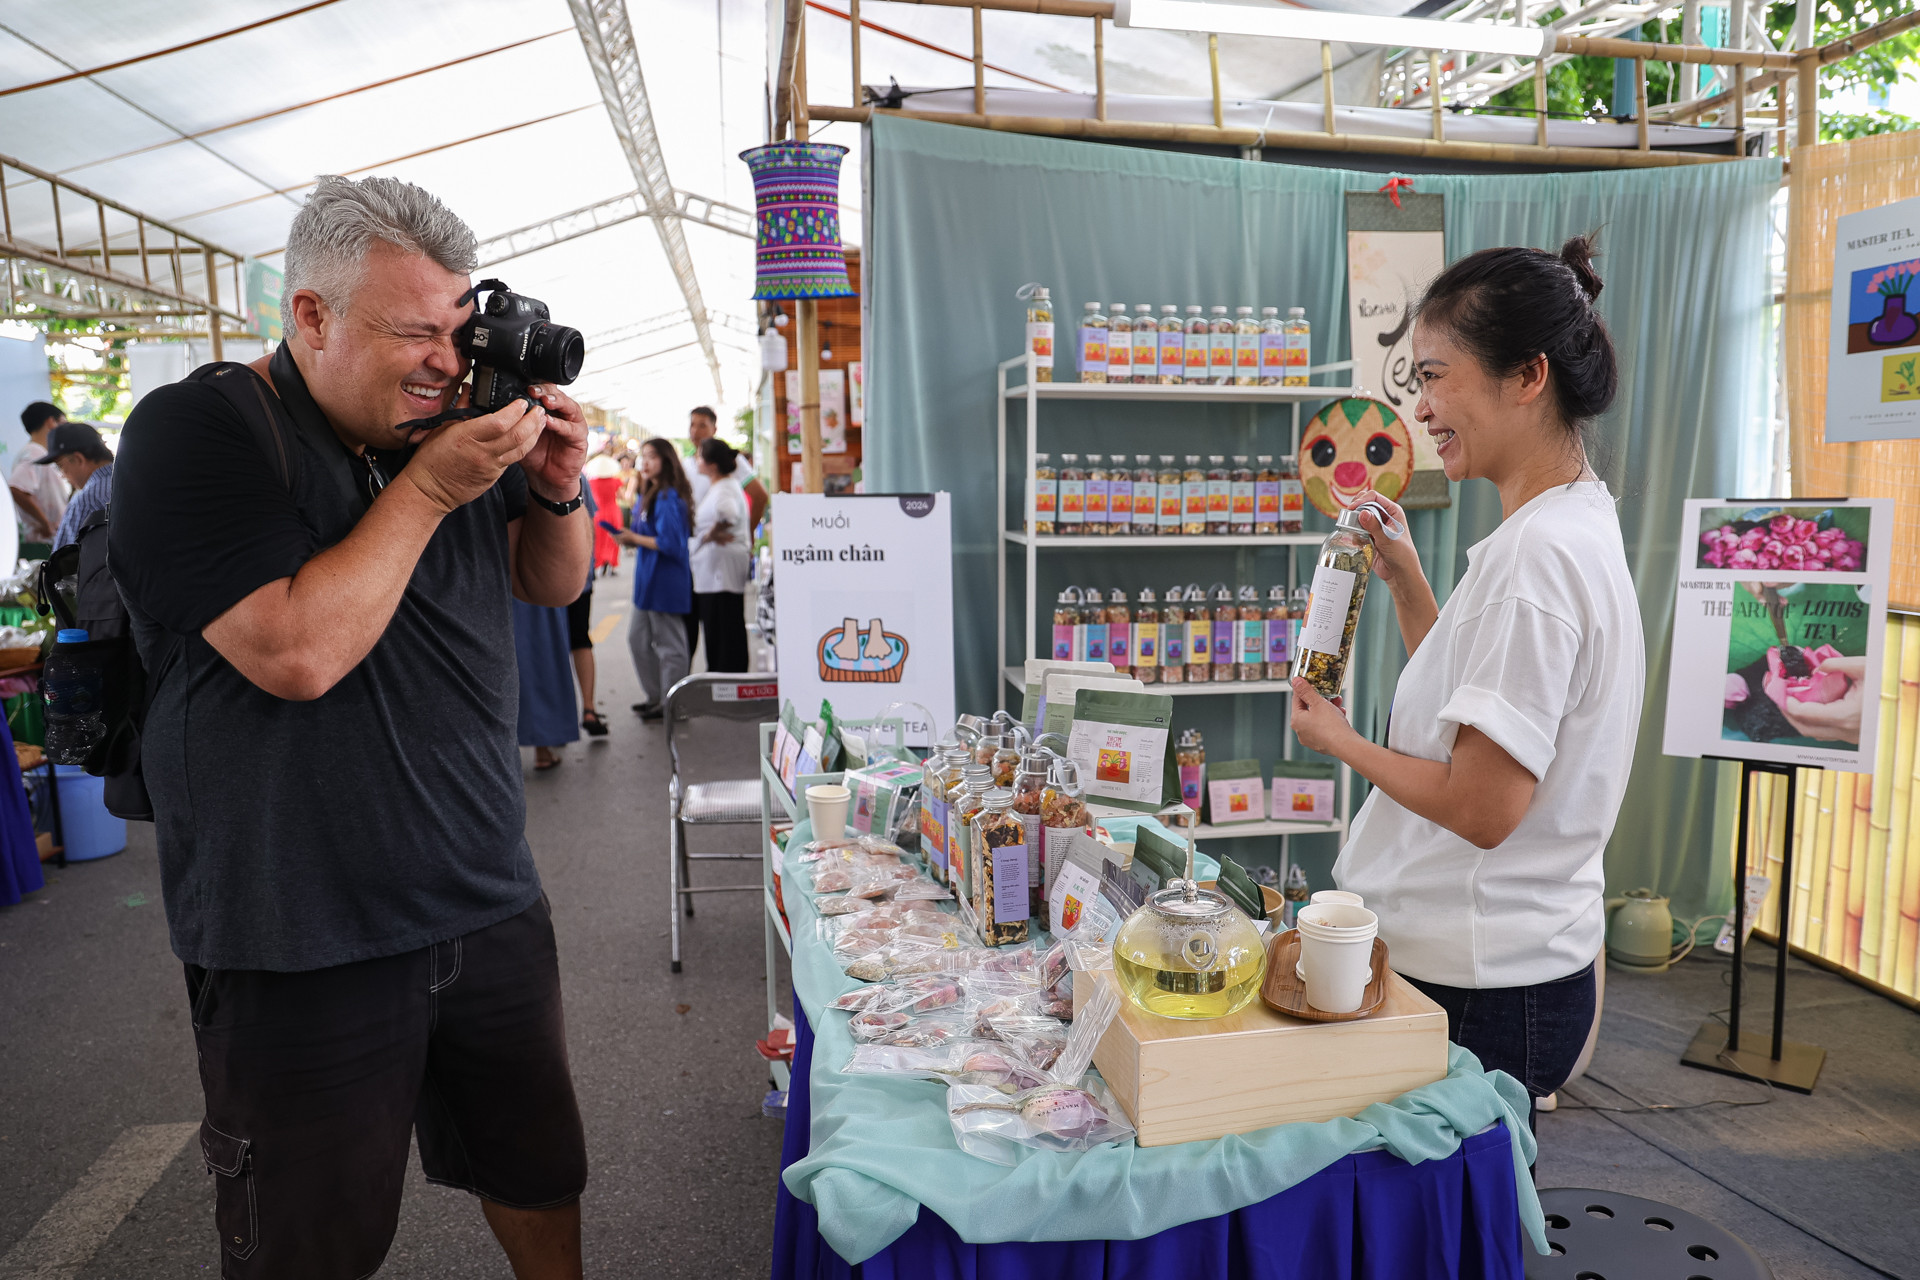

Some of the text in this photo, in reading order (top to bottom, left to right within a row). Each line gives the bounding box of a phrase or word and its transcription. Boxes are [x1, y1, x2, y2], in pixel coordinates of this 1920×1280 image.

[1847, 232, 1888, 250] MASTER
[520, 333, 529, 360] Canon
[906, 500, 929, 510] 2024
[811, 510, 851, 529] MUỐI
[782, 543, 886, 565] ngâm chân
[1680, 581, 1714, 590] MASTER
[1701, 600, 1733, 617] THE
[1736, 601, 1771, 618] ART
[1802, 599, 1865, 618] LOTUS
[1803, 622, 1838, 640] TEA
[904, 721, 928, 733] TEA
